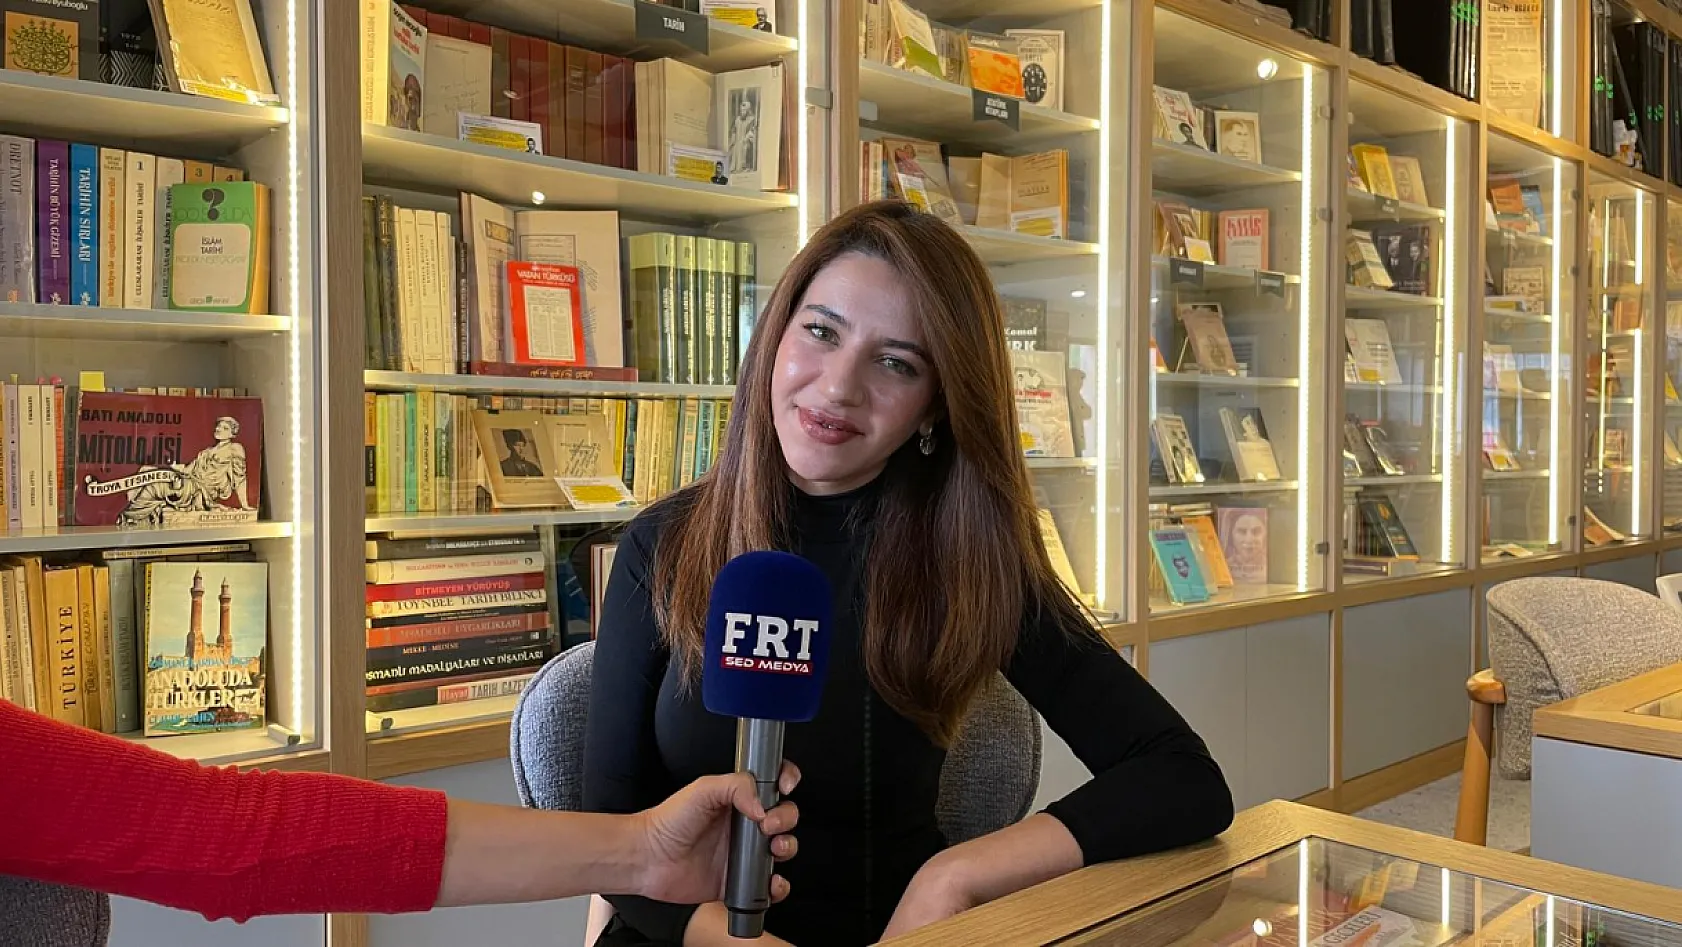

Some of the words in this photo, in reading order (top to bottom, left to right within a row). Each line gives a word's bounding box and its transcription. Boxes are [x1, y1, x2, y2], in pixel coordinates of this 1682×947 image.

[662, 17, 685, 33] TARİH
[9, 143, 22, 194] DRETNOT
[194, 168, 203, 177] 3
[78, 167, 93, 215] TARİHİN
[78, 217, 93, 262] SIRLARI
[200, 246, 223, 255] TARİHİ
[516, 269, 541, 280] VATAN
[81, 409, 113, 422] BATI
[116, 410, 182, 425] ANADOLU
[78, 429, 183, 465] MİTOLOJİSİ
[89, 481, 122, 495] TROYA
[415, 583, 464, 596] BİTMEYEN
[466, 580, 511, 592] YÜRÜYÜŞ
[397, 597, 454, 611] TOYNBEE
[461, 593, 499, 605] TARİH
[499, 589, 543, 602] BİLİNCİ
[455, 619, 521, 633] UYGARLIKLARI
[722, 612, 819, 661] FRT
[56, 605, 77, 710] TÜRKİYE
[408, 657, 481, 675] MADALYALARI
[482, 656, 496, 666] VE
[496, 650, 544, 665] NİŞANLARI
[725, 656, 755, 668] SED
[758, 660, 809, 673] MEDYA
[147, 689, 236, 709] TÜRKLER
